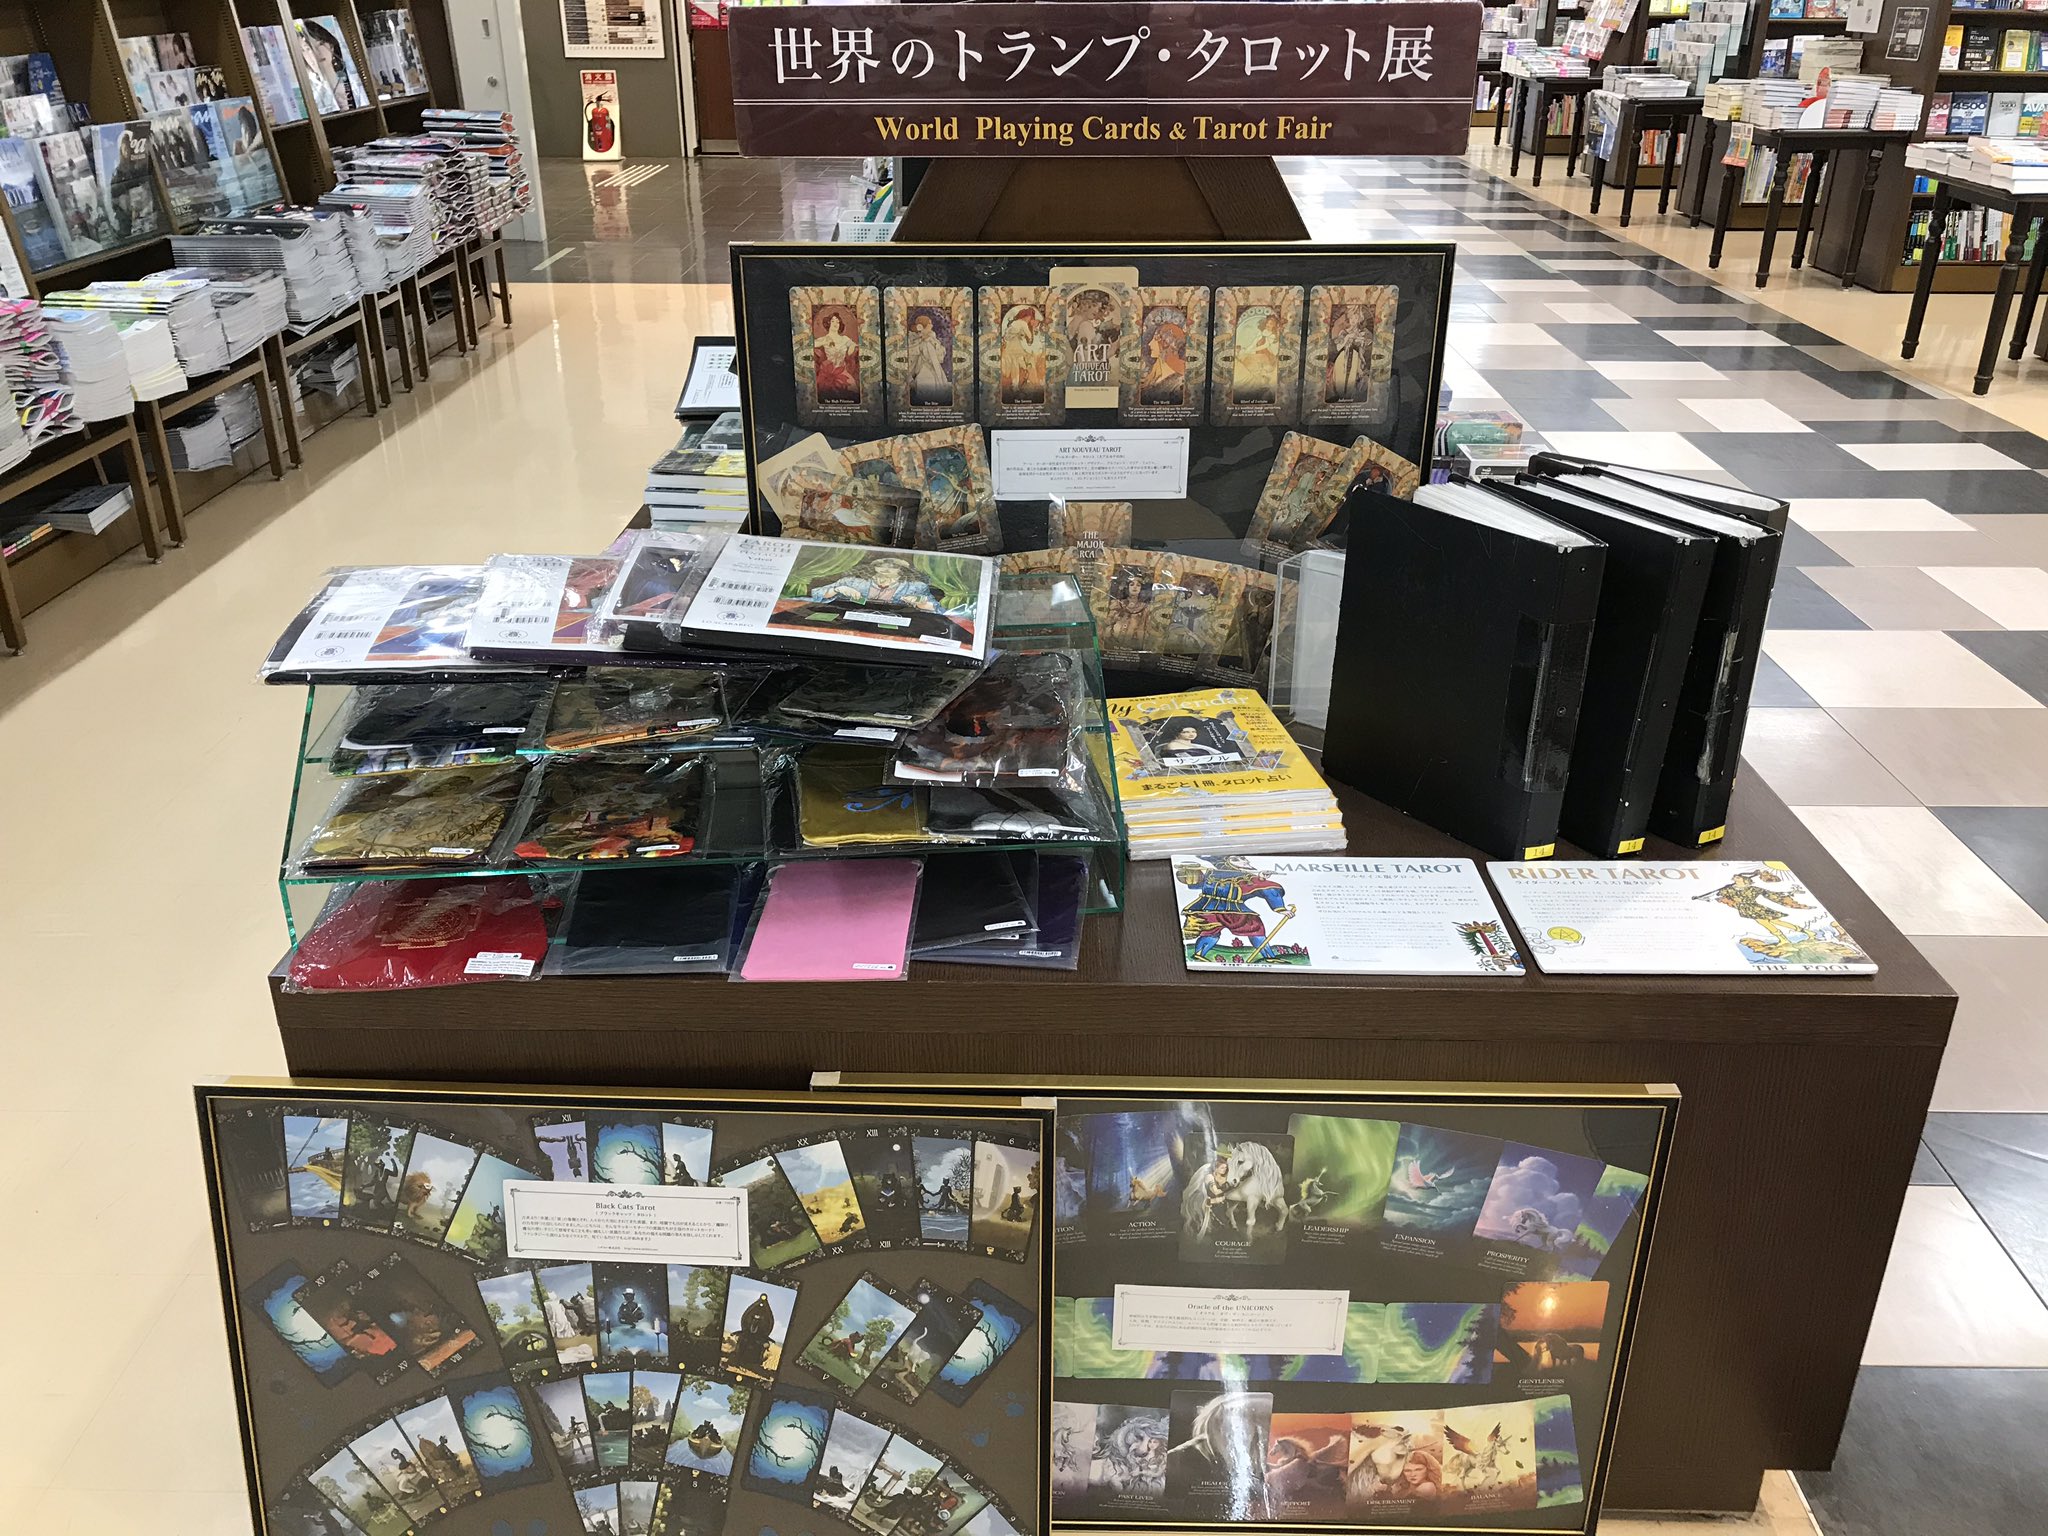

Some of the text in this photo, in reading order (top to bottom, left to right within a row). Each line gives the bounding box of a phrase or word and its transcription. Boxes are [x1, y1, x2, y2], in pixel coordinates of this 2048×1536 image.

[768, 24, 1434, 84] 世界のトランプ・タロット展
[874, 115, 1332, 146] World Playing Cards & Tarot Fair
[1073, 343, 1111, 363] ART
[1073, 362, 1111, 370] NOUVEAU
[1073, 370, 1111, 382] TAROT
[1082, 531, 1099, 539] THE
[741, 538, 794, 548] TAROT
[1079, 550, 1095, 558] RCA
[1136, 694, 1248, 714] Calendar
[1707, 831, 1717, 840] 14
[1626, 841, 1637, 851] 14
[1533, 848, 1545, 857] 14
[1274, 862, 1463, 874] MARSEILLE TAROT
[1507, 867, 1701, 880] RIDER TAROT
[595, 1202, 656, 1212] Black Cats Tarot
[1128, 1220, 1157, 1228] ACTION
[1303, 1223, 1350, 1234] LEADERSHIP
[1394, 1233, 1437, 1246] EXPANSION
[1486, 1250, 1530, 1264] PROSPERITY
[1187, 1303, 1212, 1311] Oracle
[1235, 1304, 1274, 1312] UNICORNS
